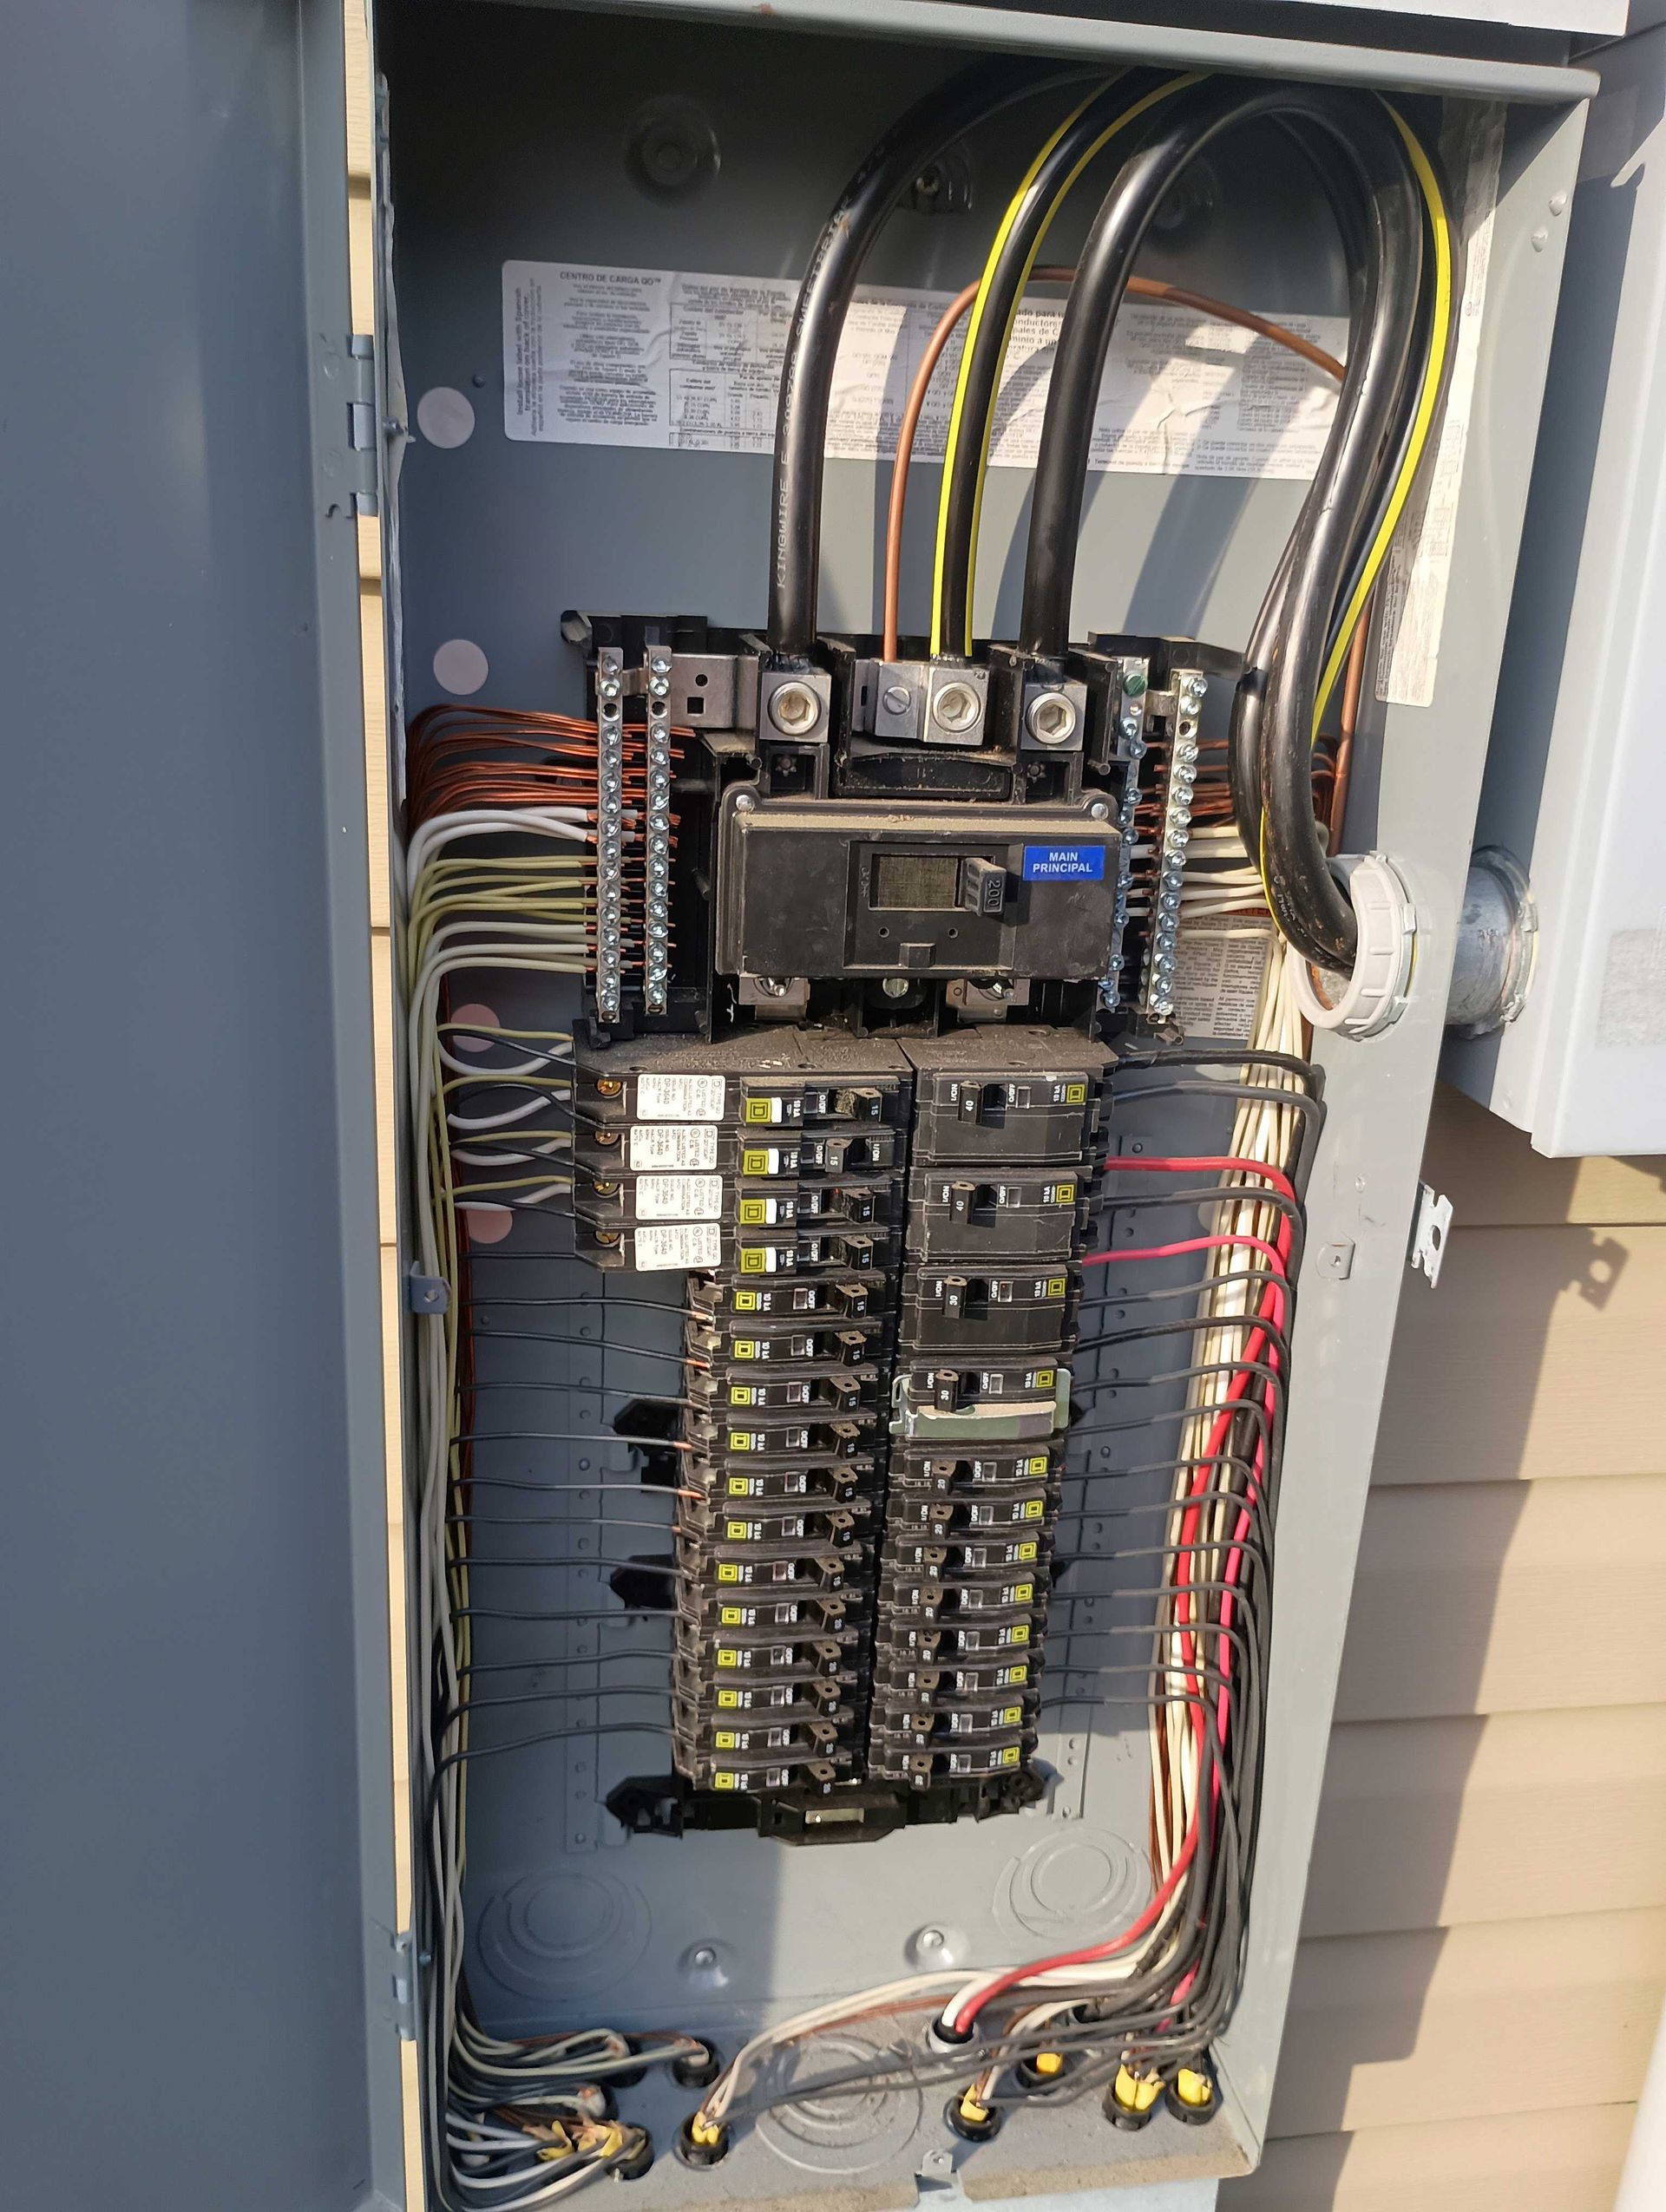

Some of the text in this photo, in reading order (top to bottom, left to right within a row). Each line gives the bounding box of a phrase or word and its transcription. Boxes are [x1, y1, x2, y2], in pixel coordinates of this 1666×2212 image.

[560, 272, 594, 282] CENTRO
[609, 275, 640, 285] CARGA
[780, 451, 789, 465] E
[777, 479, 789, 589] KINGWIRE
[1049, 852, 1078, 862] MAIN
[1033, 863, 1093, 874] PRINCIPAL
[987, 880, 1001, 907] 200
[950, 1083, 959, 1102] I/ON
[871, 1105, 878, 1116] 15
[965, 1100, 974, 1111] 40
[872, 1143, 881, 1162] I/ON
[830, 1155, 838, 1166] 15
[1043, 1194, 1051, 1203] 10
[863, 1206, 870, 1216] 15
[955, 1201, 964, 1211] 40
[863, 1253, 869, 1264] 15
[1034, 1289, 1041, 1298] 10
[949, 1295, 958, 1306] 30
[856, 1301, 864, 1312] 15
[853, 1350, 860, 1360] 15
[941, 1390, 949, 1400] 30
[849, 1397, 856, 1407] 15
[938, 1479, 946, 1489] 20
[935, 1524, 943, 1535] 20
[929, 1566, 938, 1577] 20
[926, 1607, 934, 1618] 20
